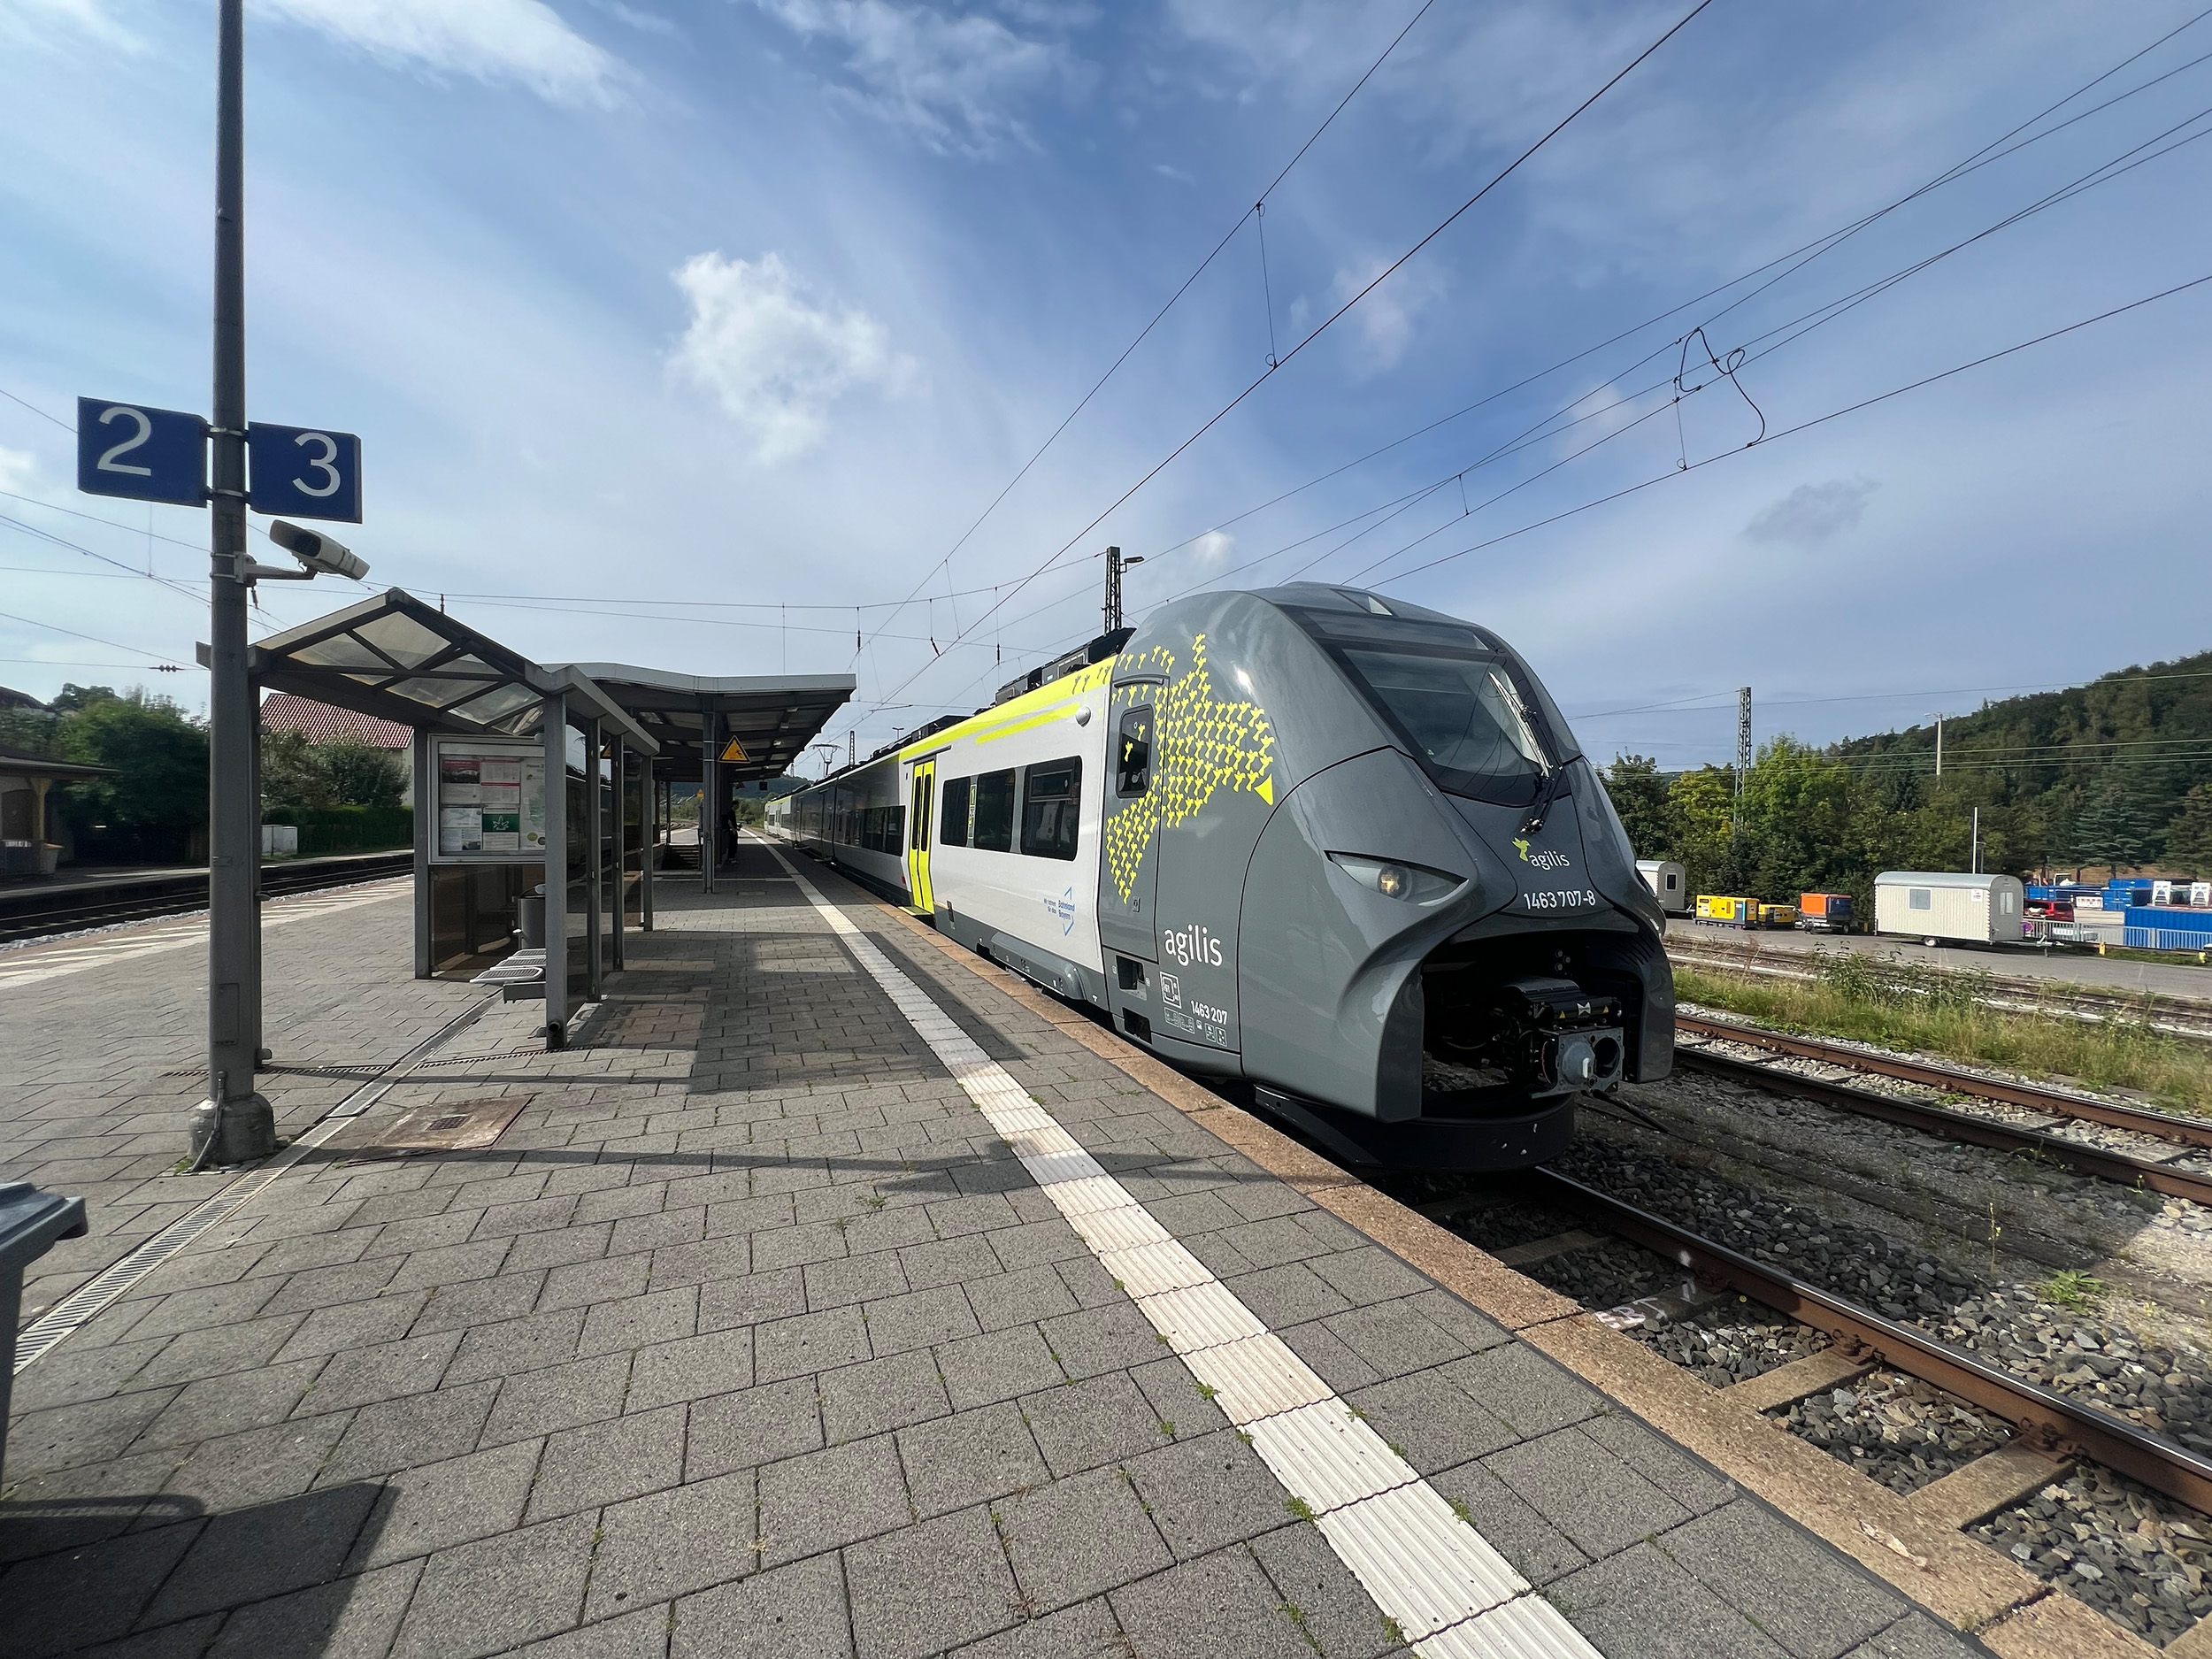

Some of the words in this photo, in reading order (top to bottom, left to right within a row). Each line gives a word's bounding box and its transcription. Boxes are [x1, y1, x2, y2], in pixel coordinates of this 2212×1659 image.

[96, 406, 151, 477] 2
[292, 432, 341, 497] 3
[1529, 850, 1571, 871] agilis
[1524, 891, 1556, 910] 1463
[1557, 889, 1596, 908] 707-8
[1164, 924, 1223, 966] agilis
[1190, 1000, 1210, 1019] 1463
[1210, 1007, 1228, 1025] 207
